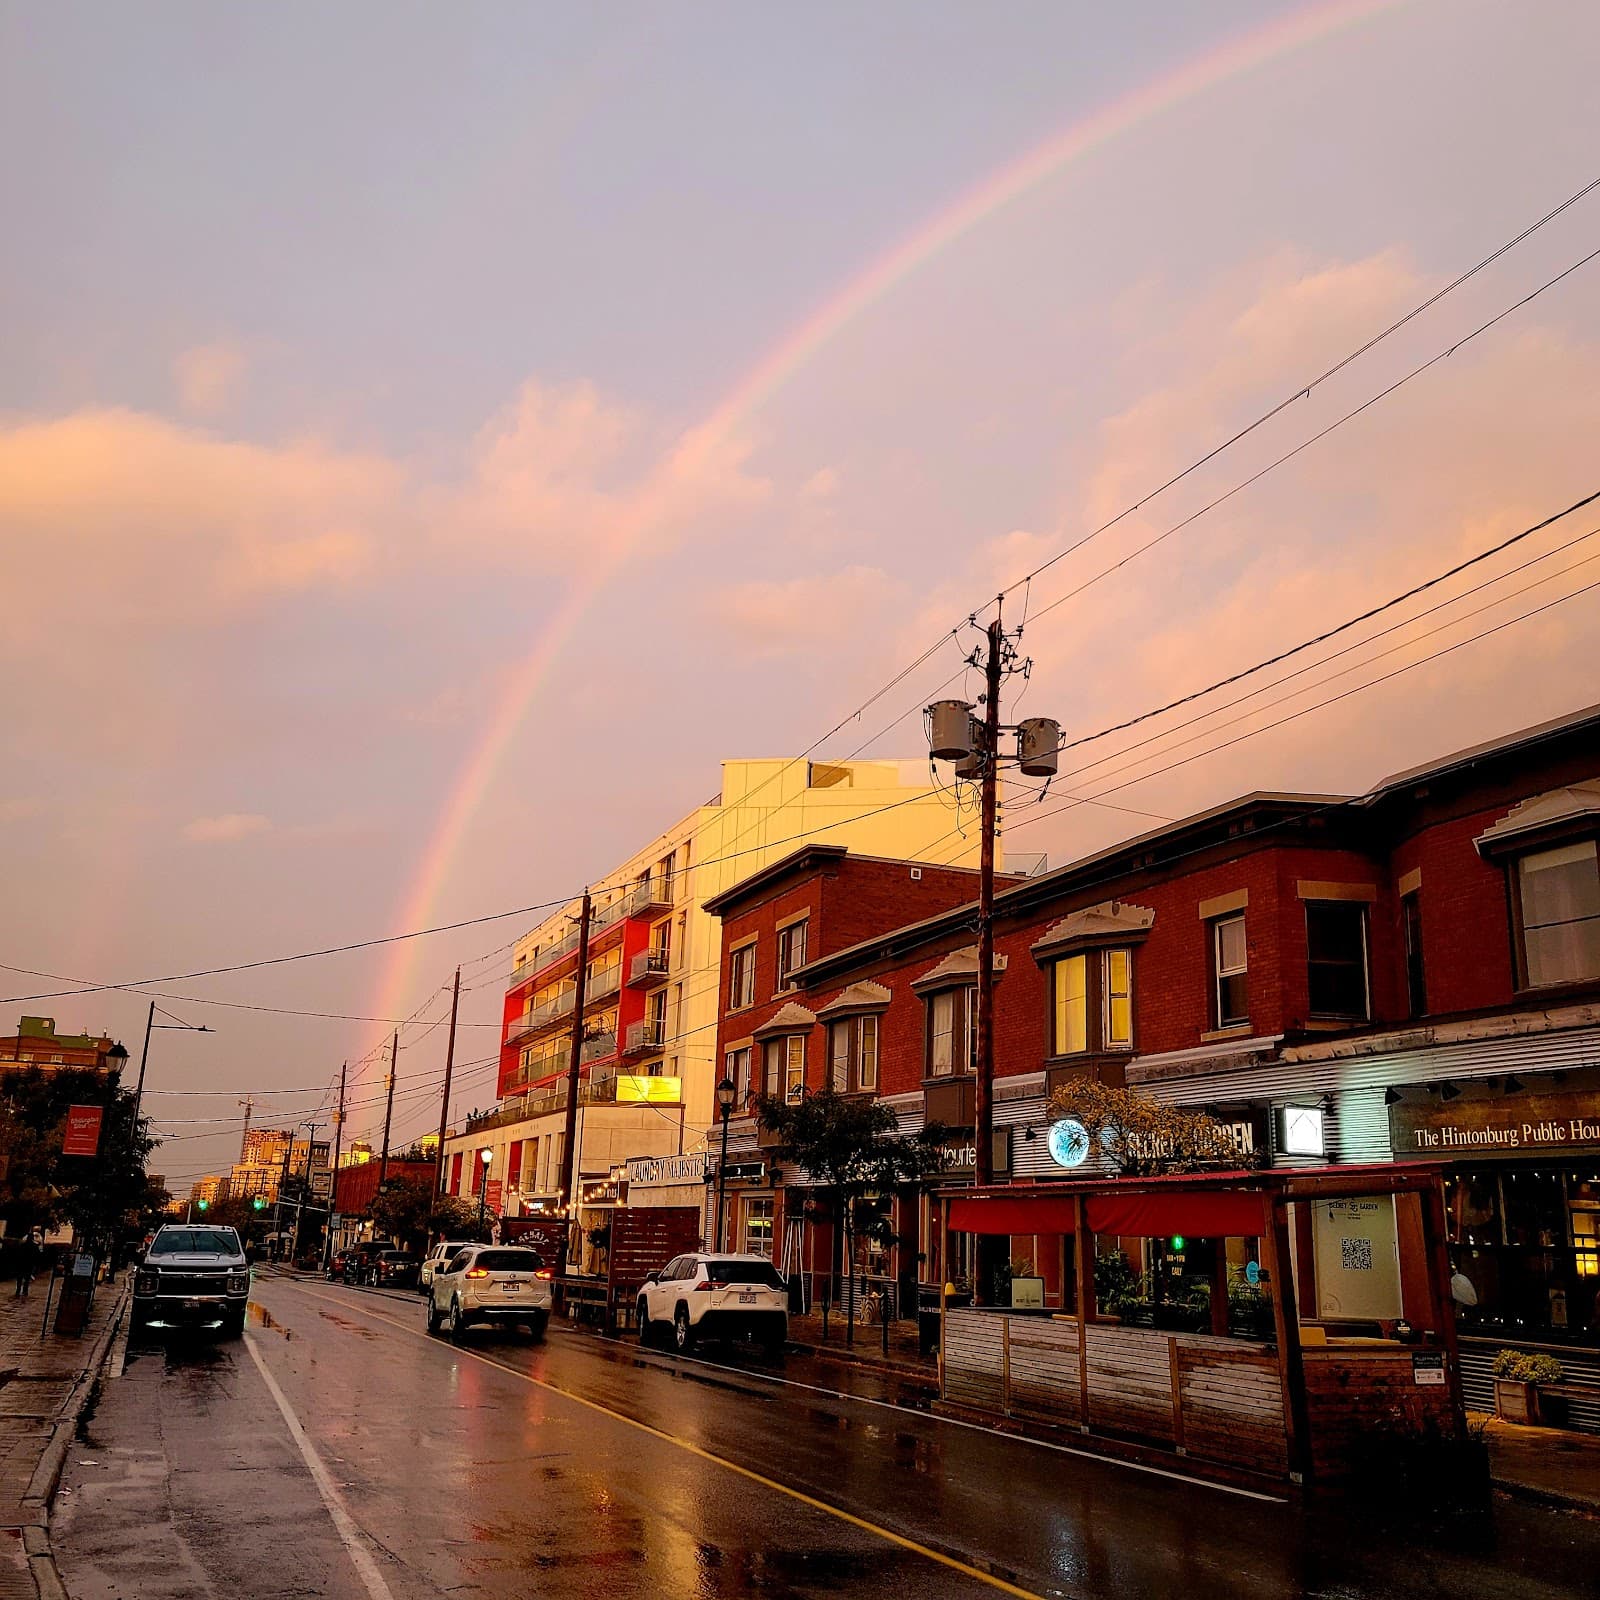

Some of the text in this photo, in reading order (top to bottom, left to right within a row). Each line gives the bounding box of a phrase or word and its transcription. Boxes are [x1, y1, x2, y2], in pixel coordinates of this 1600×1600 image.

[1414, 1129, 1439, 1147] The
[1441, 1126, 1519, 1147] Hintonburg
[1522, 1121, 1566, 1142] Public
[630, 1158, 704, 1183] LAUNDRY MAJESTIC
